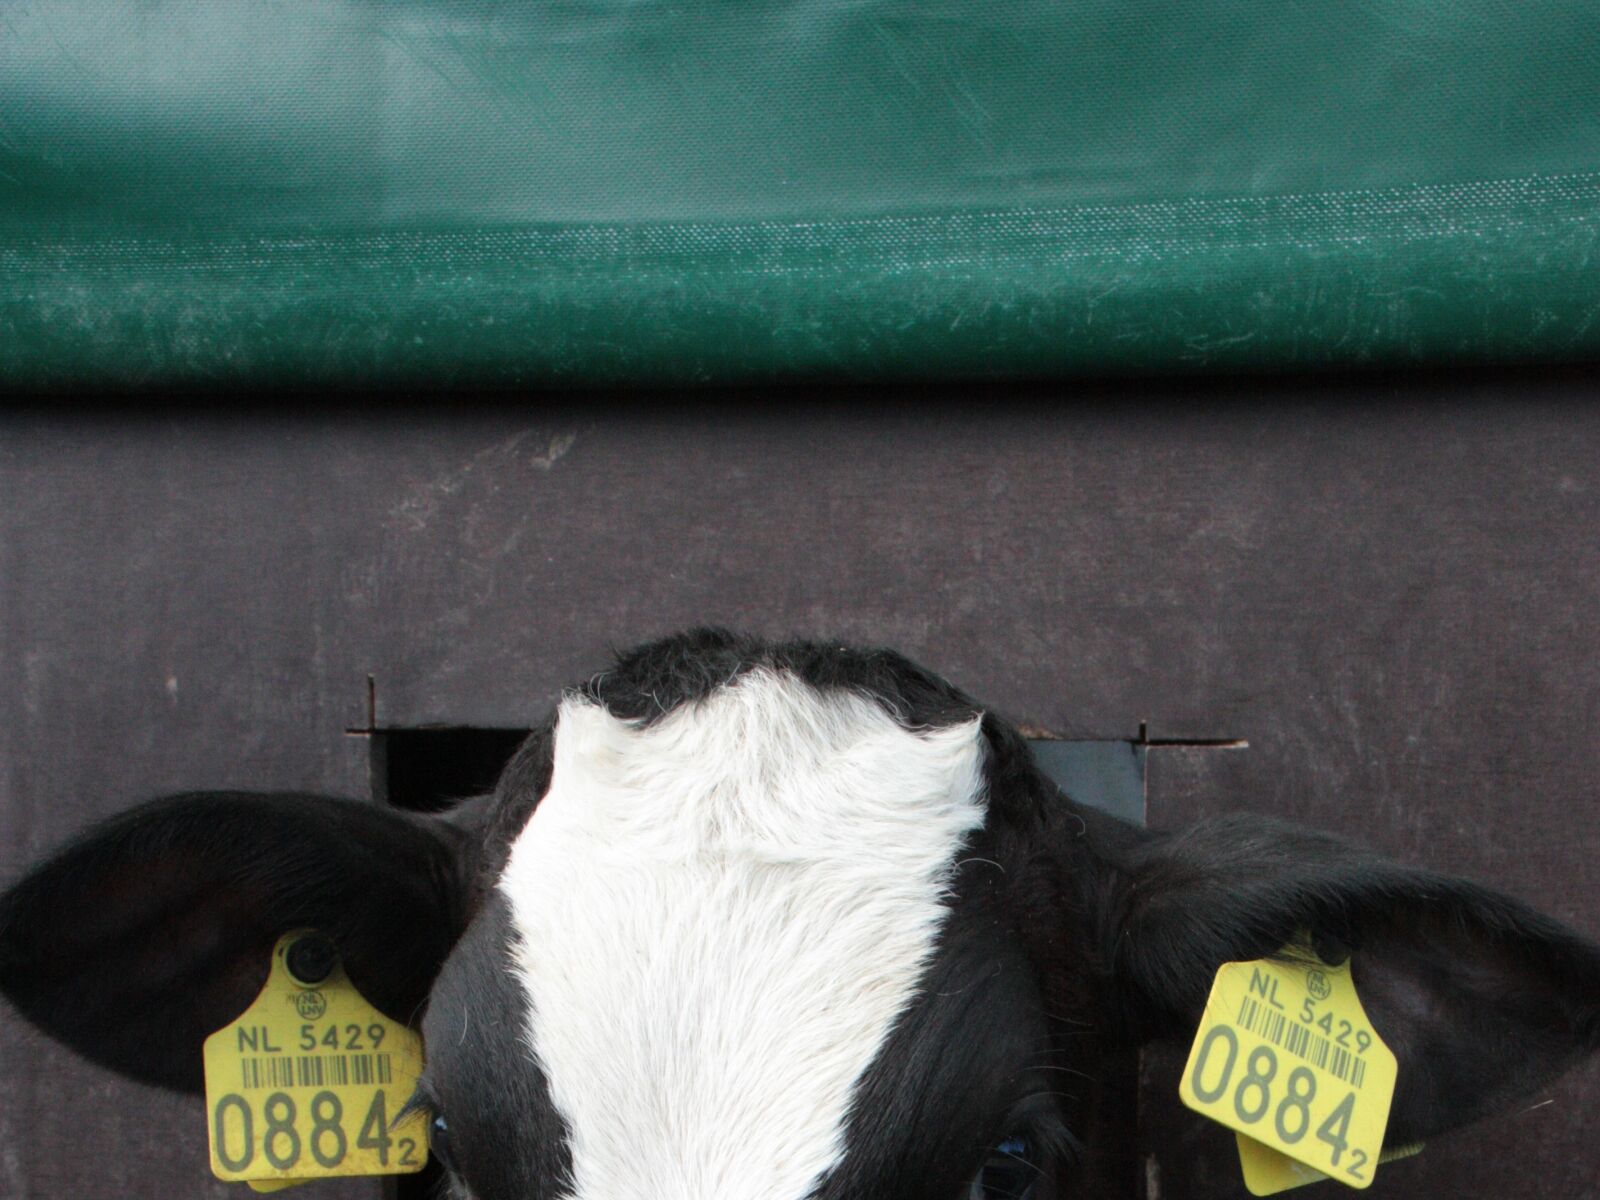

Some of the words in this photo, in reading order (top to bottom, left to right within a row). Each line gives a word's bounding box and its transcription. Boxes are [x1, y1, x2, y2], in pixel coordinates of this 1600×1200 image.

[237, 1025, 282, 1053] NL
[299, 1023, 386, 1051] 5429
[1249, 967, 1285, 1011] NL
[1299, 997, 1372, 1055] 5429
[214, 1088, 393, 1173] 0884
[1191, 1024, 1356, 1167] 0884
